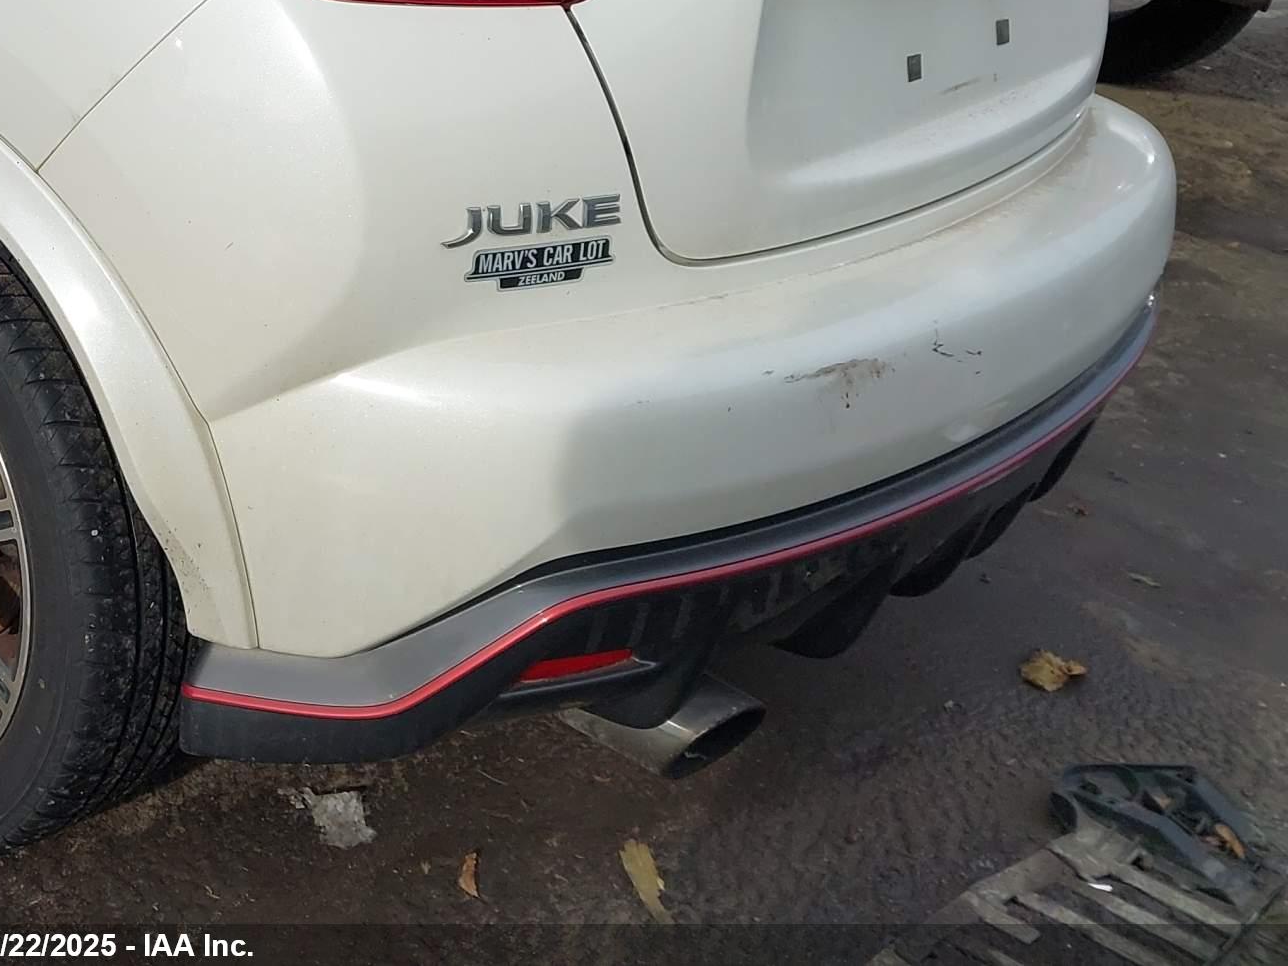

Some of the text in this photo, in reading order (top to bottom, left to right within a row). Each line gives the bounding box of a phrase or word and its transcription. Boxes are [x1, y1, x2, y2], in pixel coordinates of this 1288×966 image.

[440, 193, 621, 249] JUKE
[478, 239, 607, 273] MARV'S CAR LOT
[518, 271, 566, 287] ZEELAND
